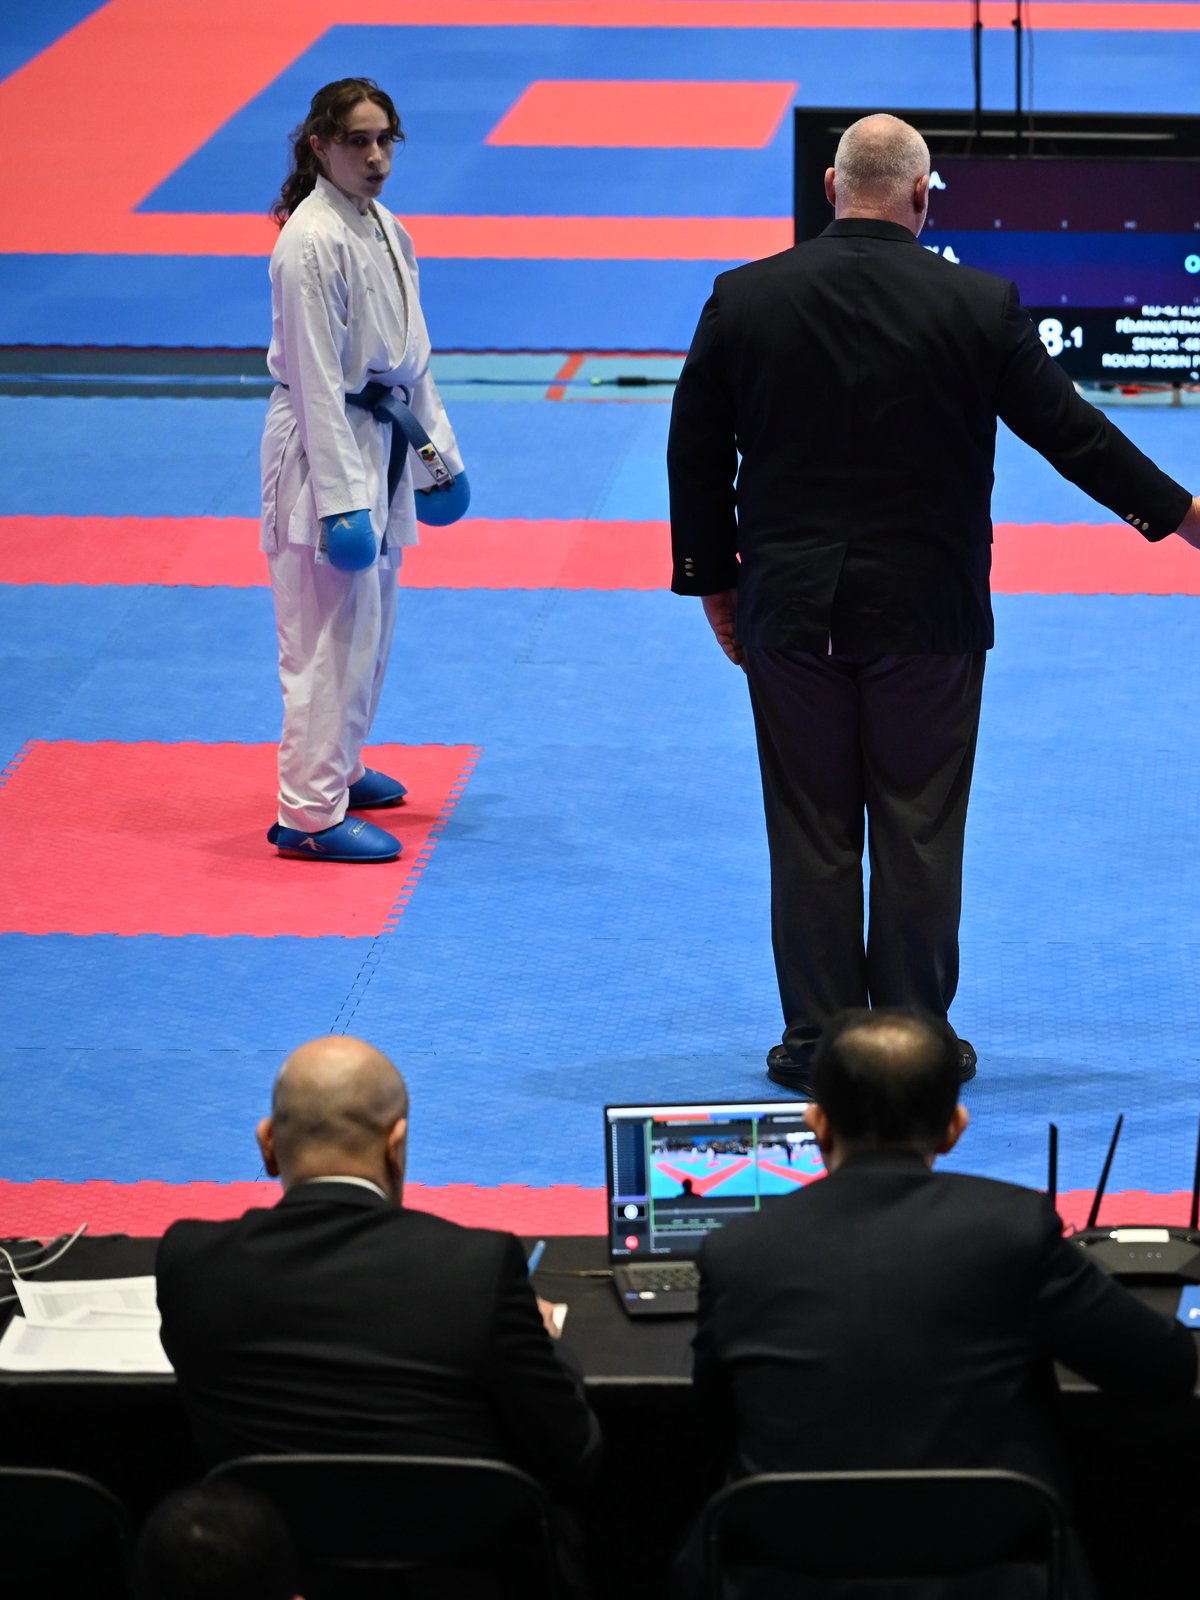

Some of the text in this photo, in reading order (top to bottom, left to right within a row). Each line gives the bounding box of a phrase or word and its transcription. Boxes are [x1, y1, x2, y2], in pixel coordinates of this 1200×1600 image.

[1131, 336, 1179, 352] SENIOR
[1102, 353, 1150, 369] ROUND
[1150, 354, 1192, 369] ROBIN
